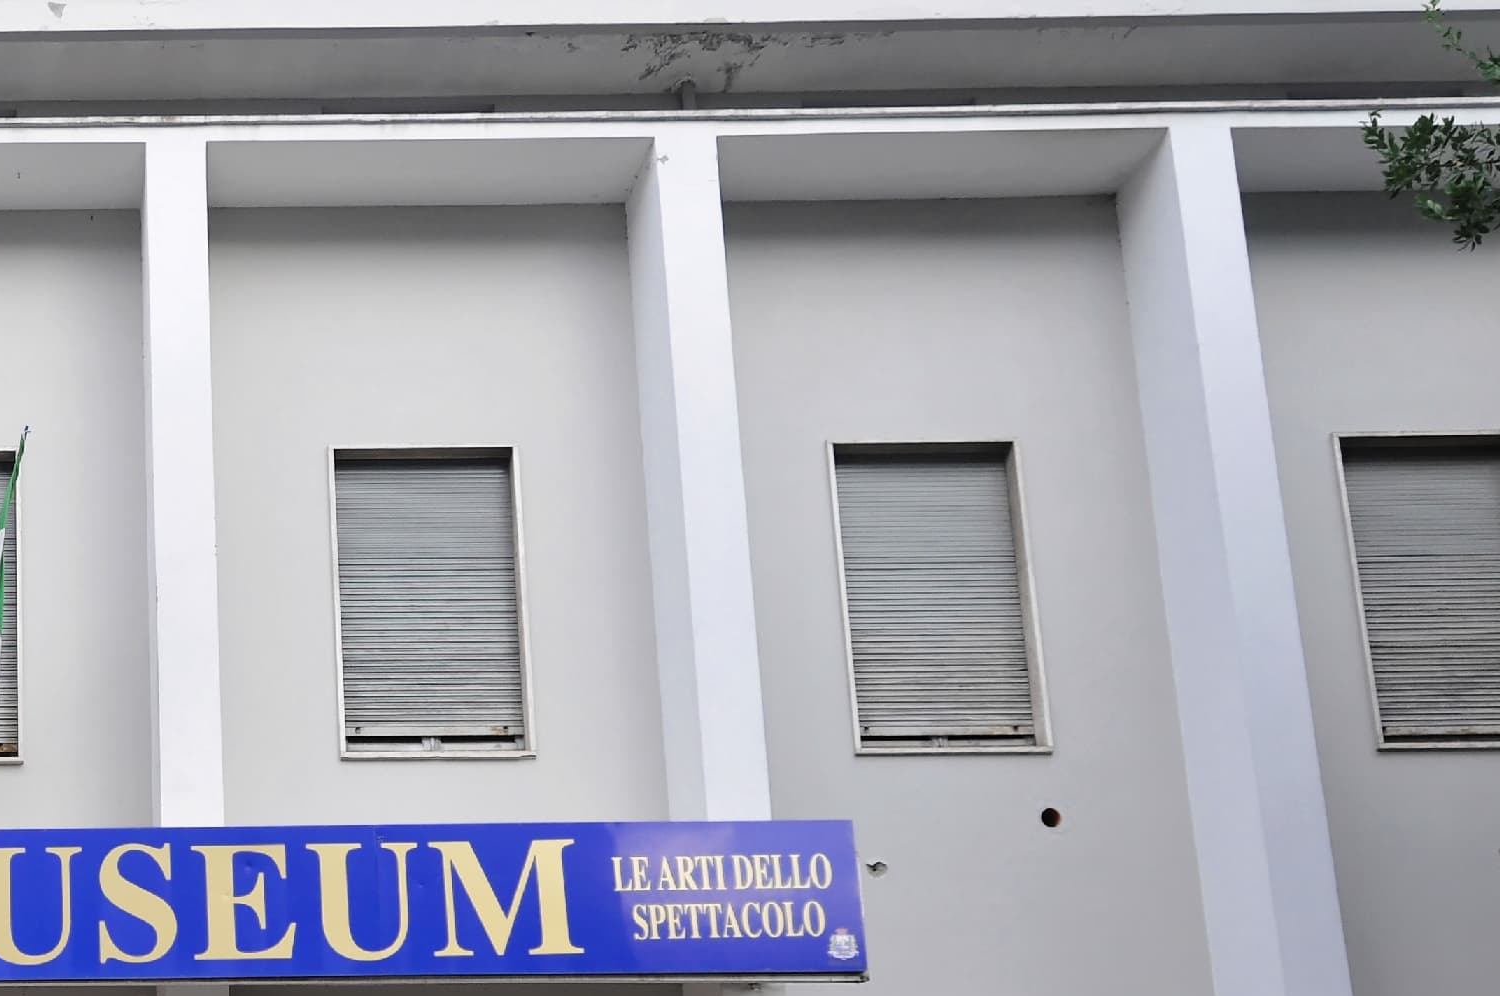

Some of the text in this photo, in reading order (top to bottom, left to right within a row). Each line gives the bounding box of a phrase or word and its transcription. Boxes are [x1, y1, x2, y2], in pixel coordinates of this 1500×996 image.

[611, 853, 833, 892] LE ARTI DELLO
[632, 900, 827, 940] SPETTACOLO
